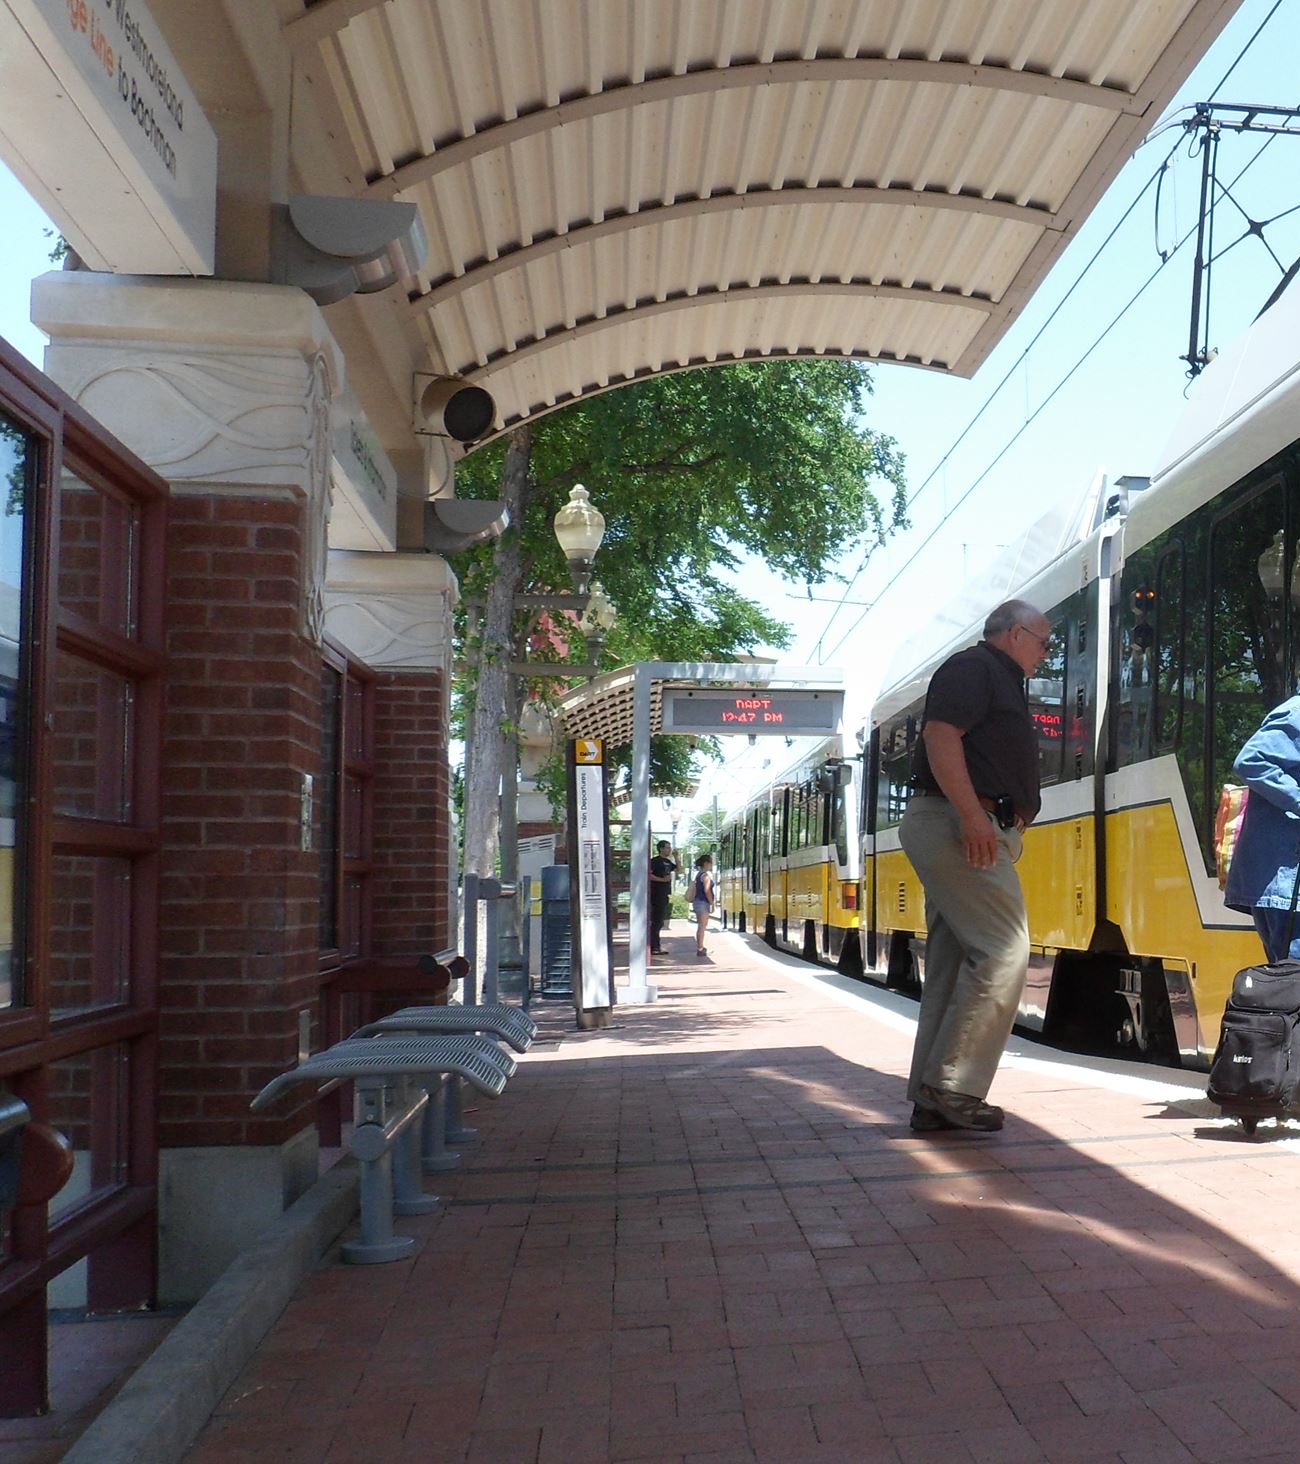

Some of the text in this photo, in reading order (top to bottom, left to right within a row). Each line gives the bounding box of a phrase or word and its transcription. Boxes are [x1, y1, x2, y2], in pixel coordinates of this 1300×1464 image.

[90, 8, 114, 78] Line
[118, 54, 129, 102] to
[130, 77, 177, 181] Bachman
